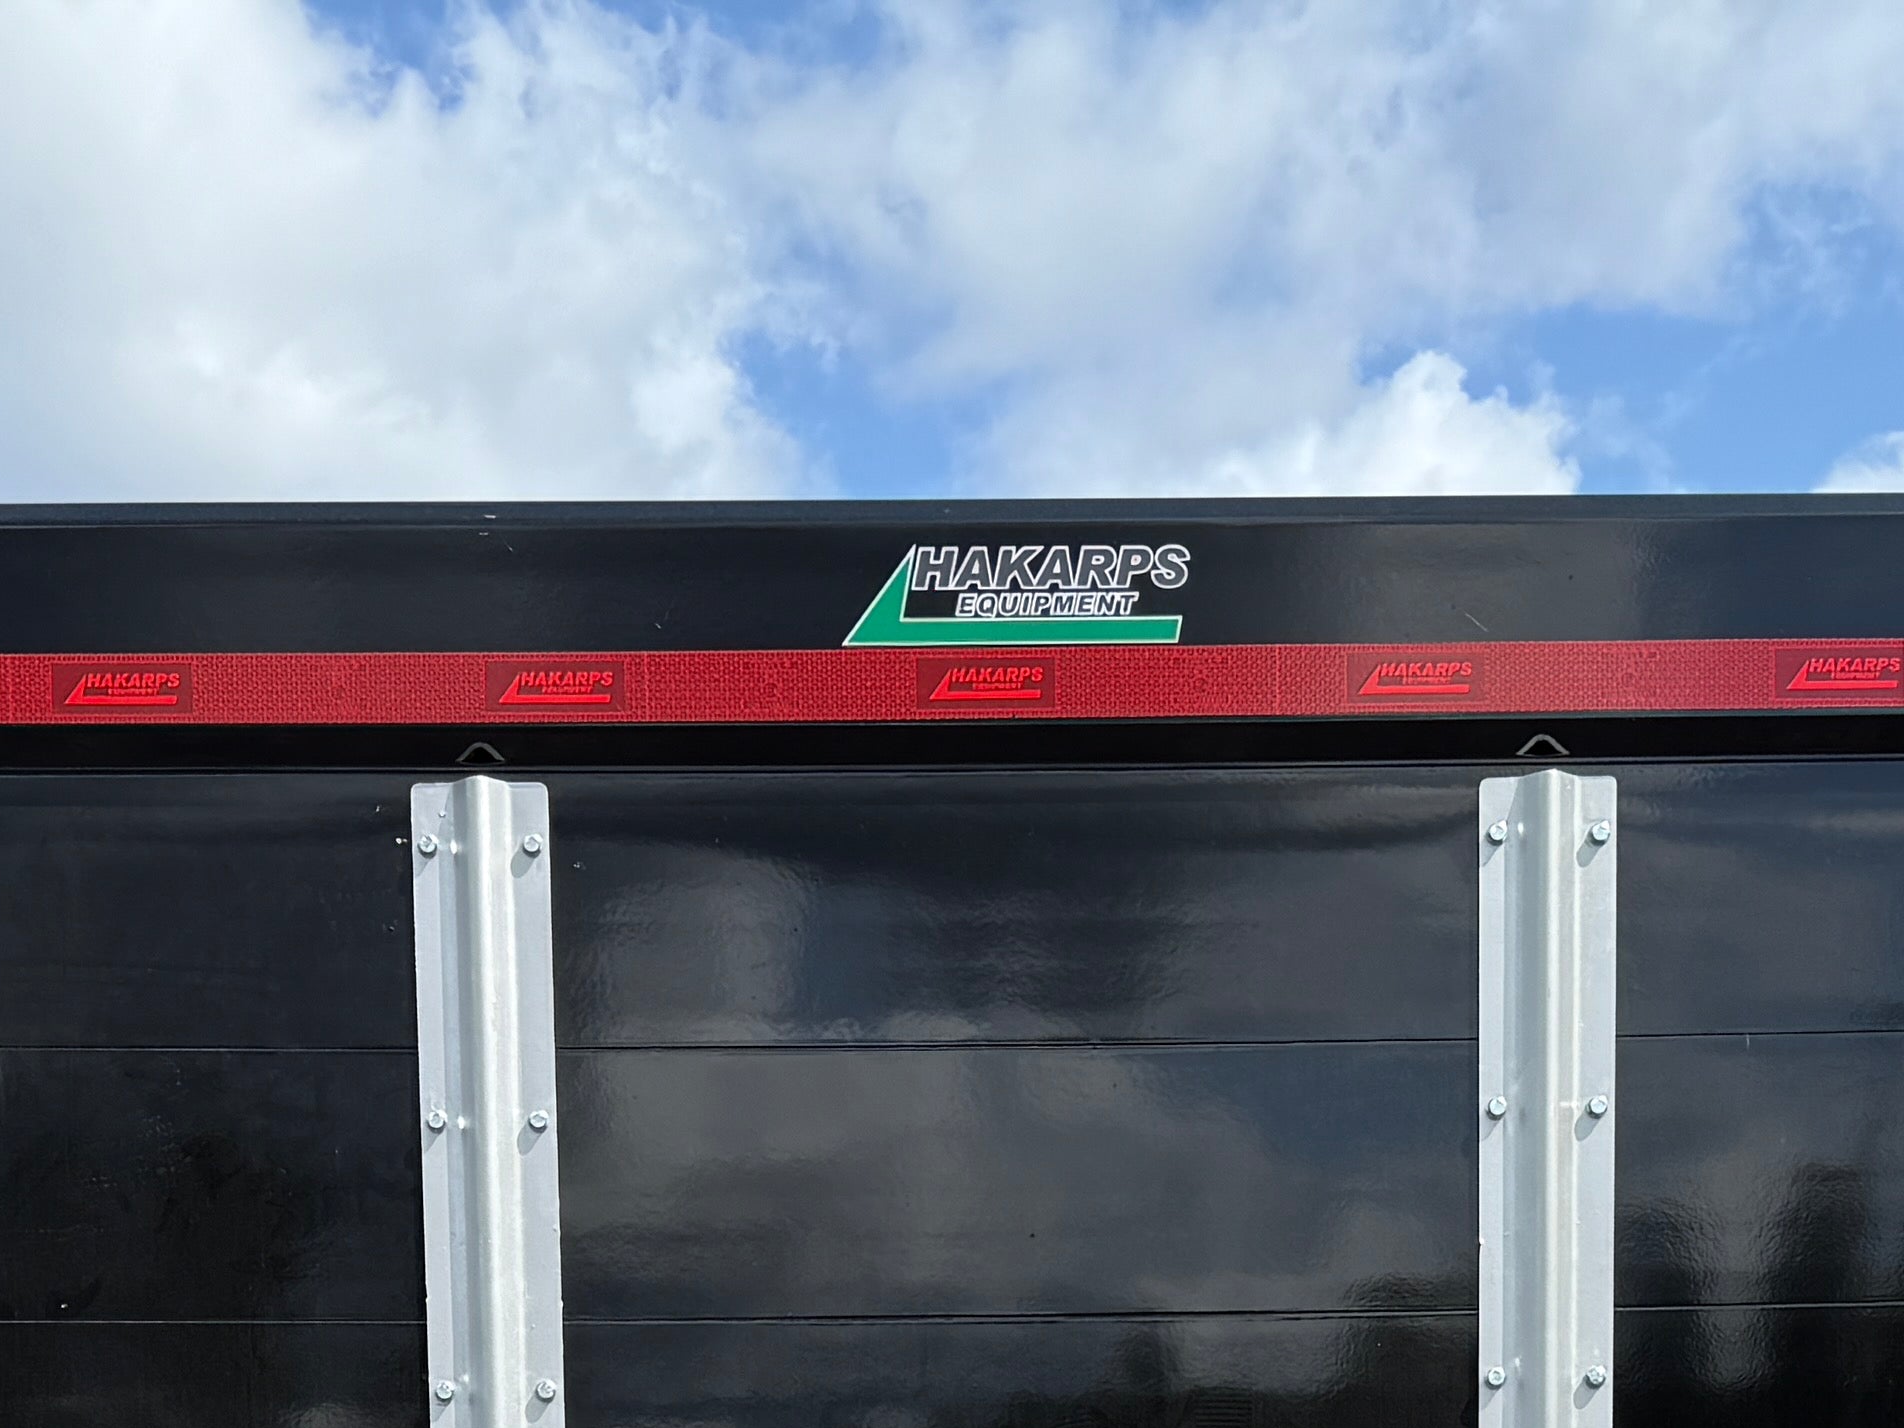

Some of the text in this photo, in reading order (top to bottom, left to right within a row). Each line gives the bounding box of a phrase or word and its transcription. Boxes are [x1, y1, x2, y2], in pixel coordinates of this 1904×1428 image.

[911, 544, 1190, 590] HAKARPS
[955, 592, 1139, 618] EQUIPMENT
[1381, 662, 1472, 677] HAKARPS
[1809, 658, 1900, 672] HAKARPS
[87, 673, 180, 687] HAKARPS
[521, 671, 613, 686] HAKARPS
[952, 667, 1043, 682] HAKARPS
